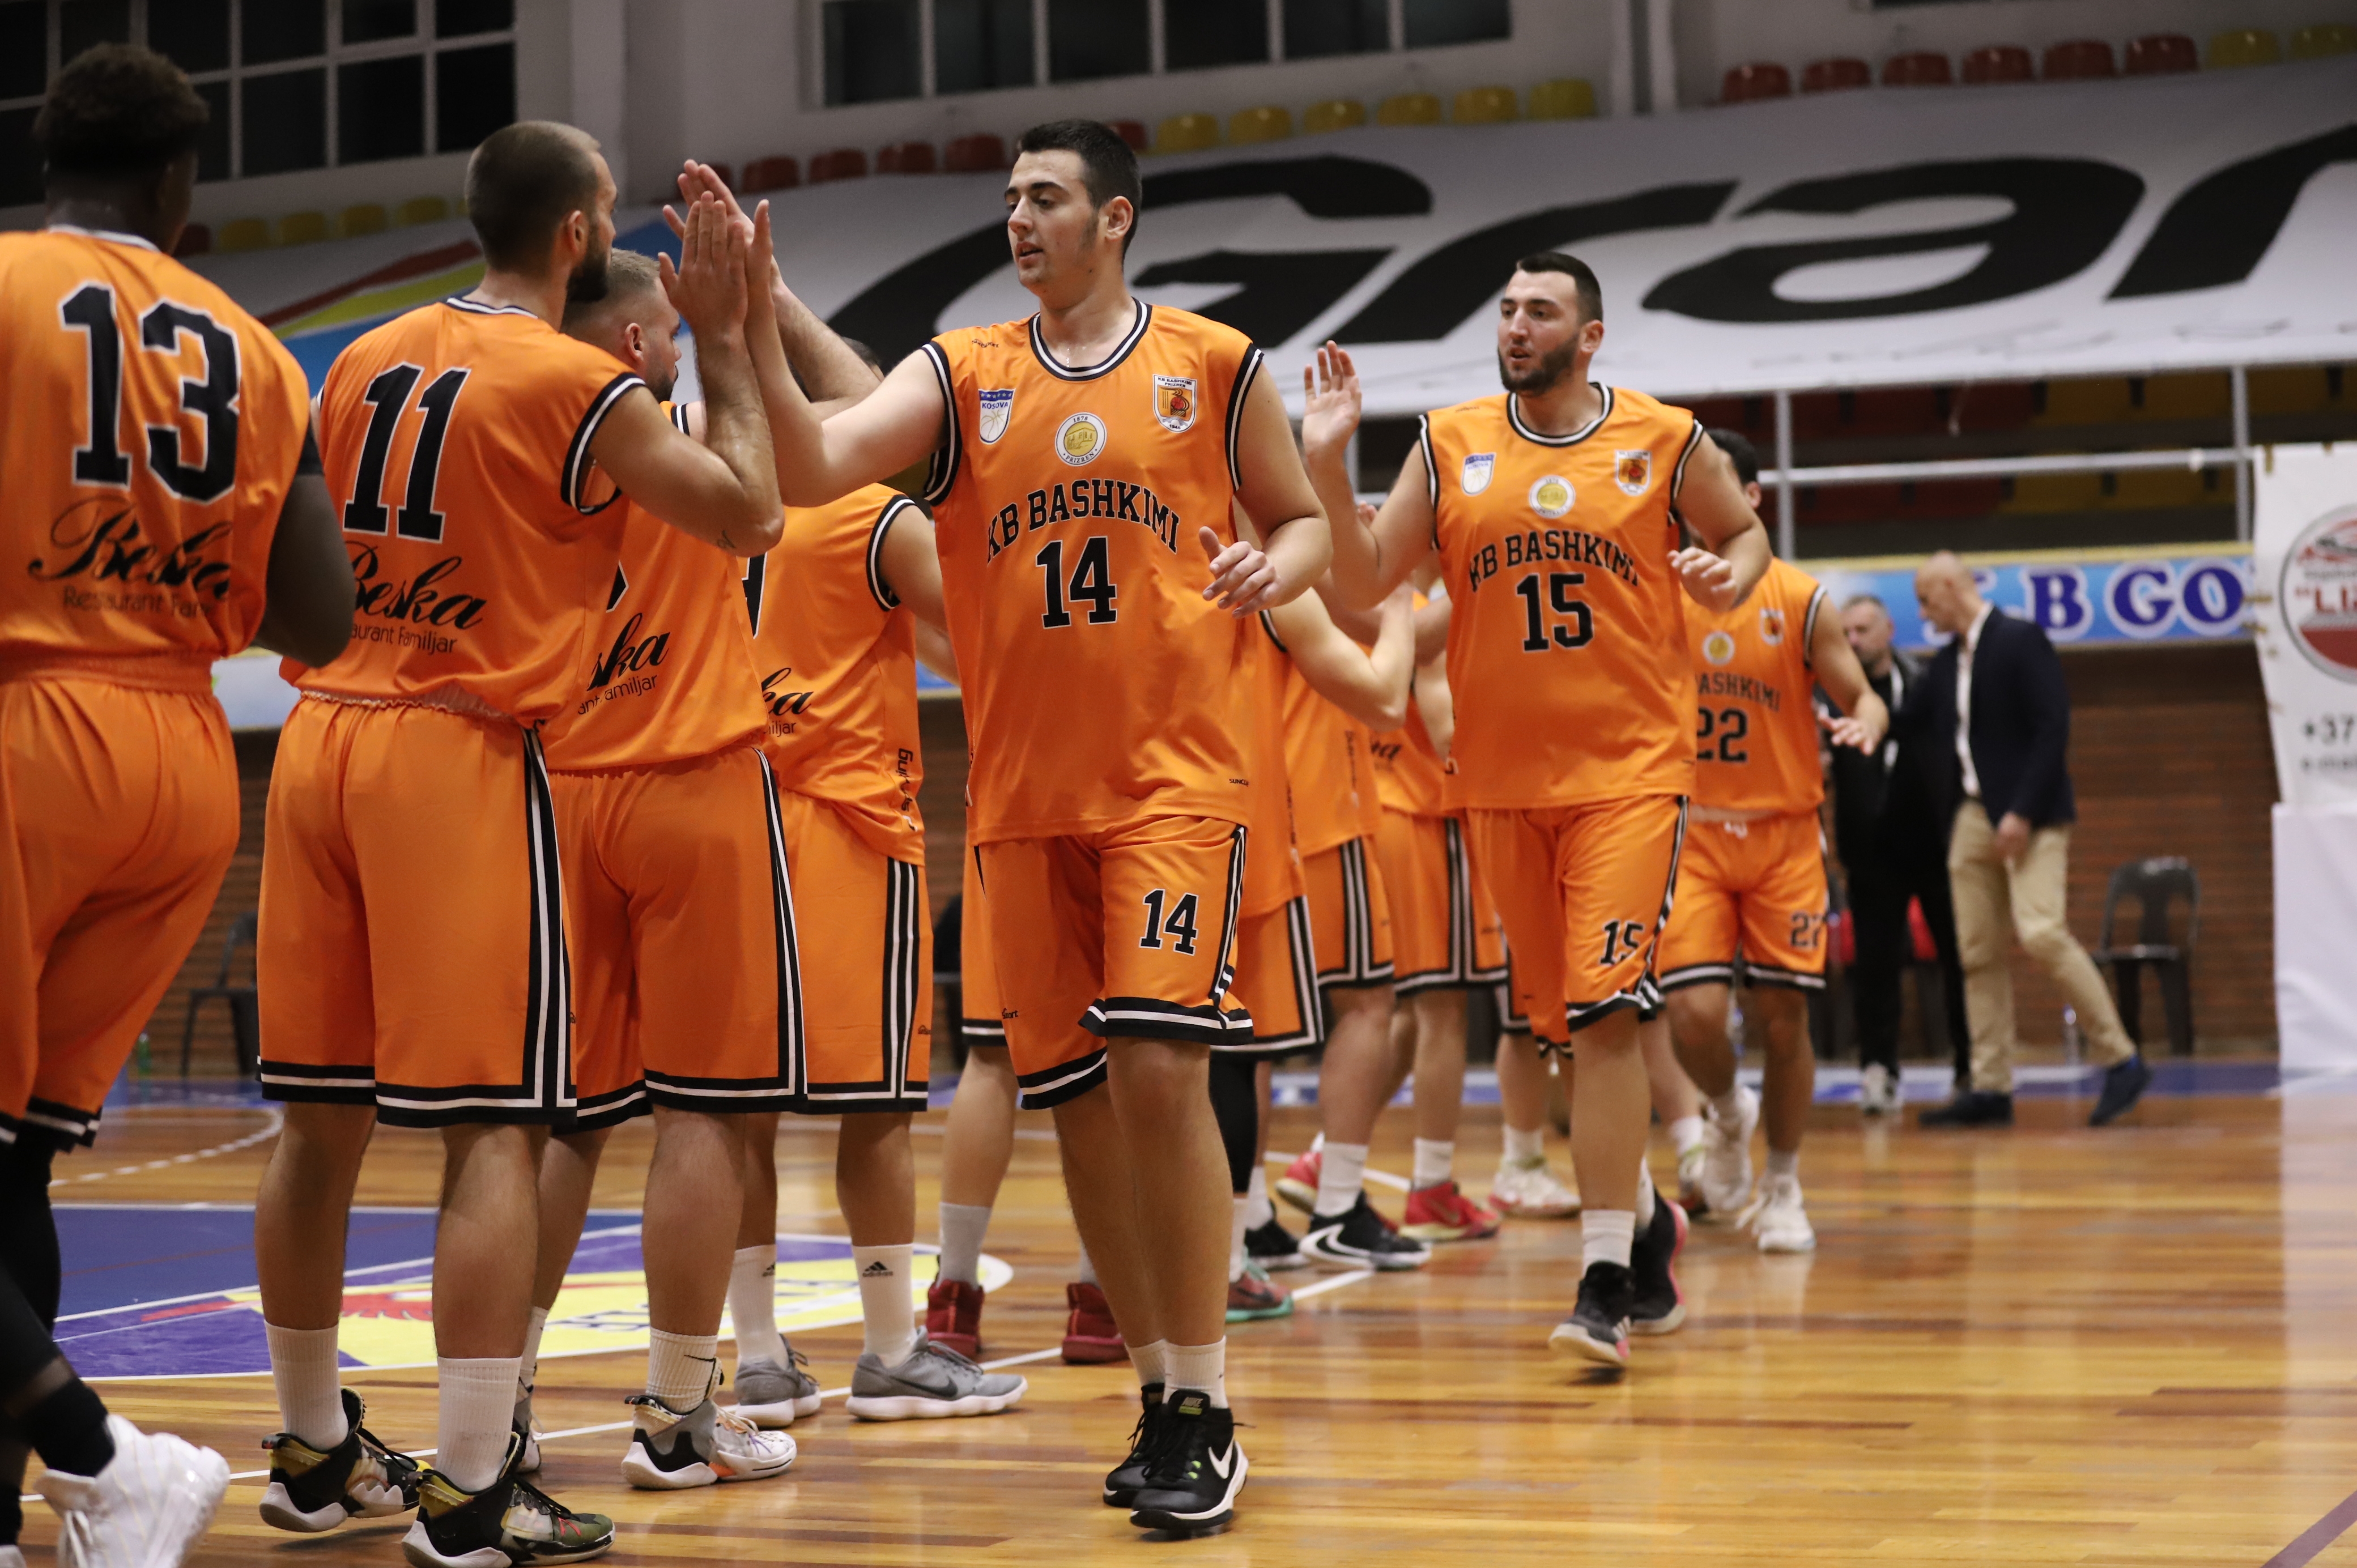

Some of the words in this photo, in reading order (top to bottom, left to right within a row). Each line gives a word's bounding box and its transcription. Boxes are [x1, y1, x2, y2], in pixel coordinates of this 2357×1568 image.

[59, 280, 240, 505] 13
[342, 361, 471, 543] 11
[1065, 451, 1095, 463] PRIZREN
[986, 502, 1019, 565] KB
[1027, 478, 1180, 555] BASHKIMI
[1036, 535, 1118, 630] 14
[1470, 543, 1499, 593] KB
[1516, 572, 1594, 653] 15
[1696, 671, 1780, 713] ASHKIMI
[1139, 888, 1199, 956] 14
[1599, 919, 1644, 965] 15
